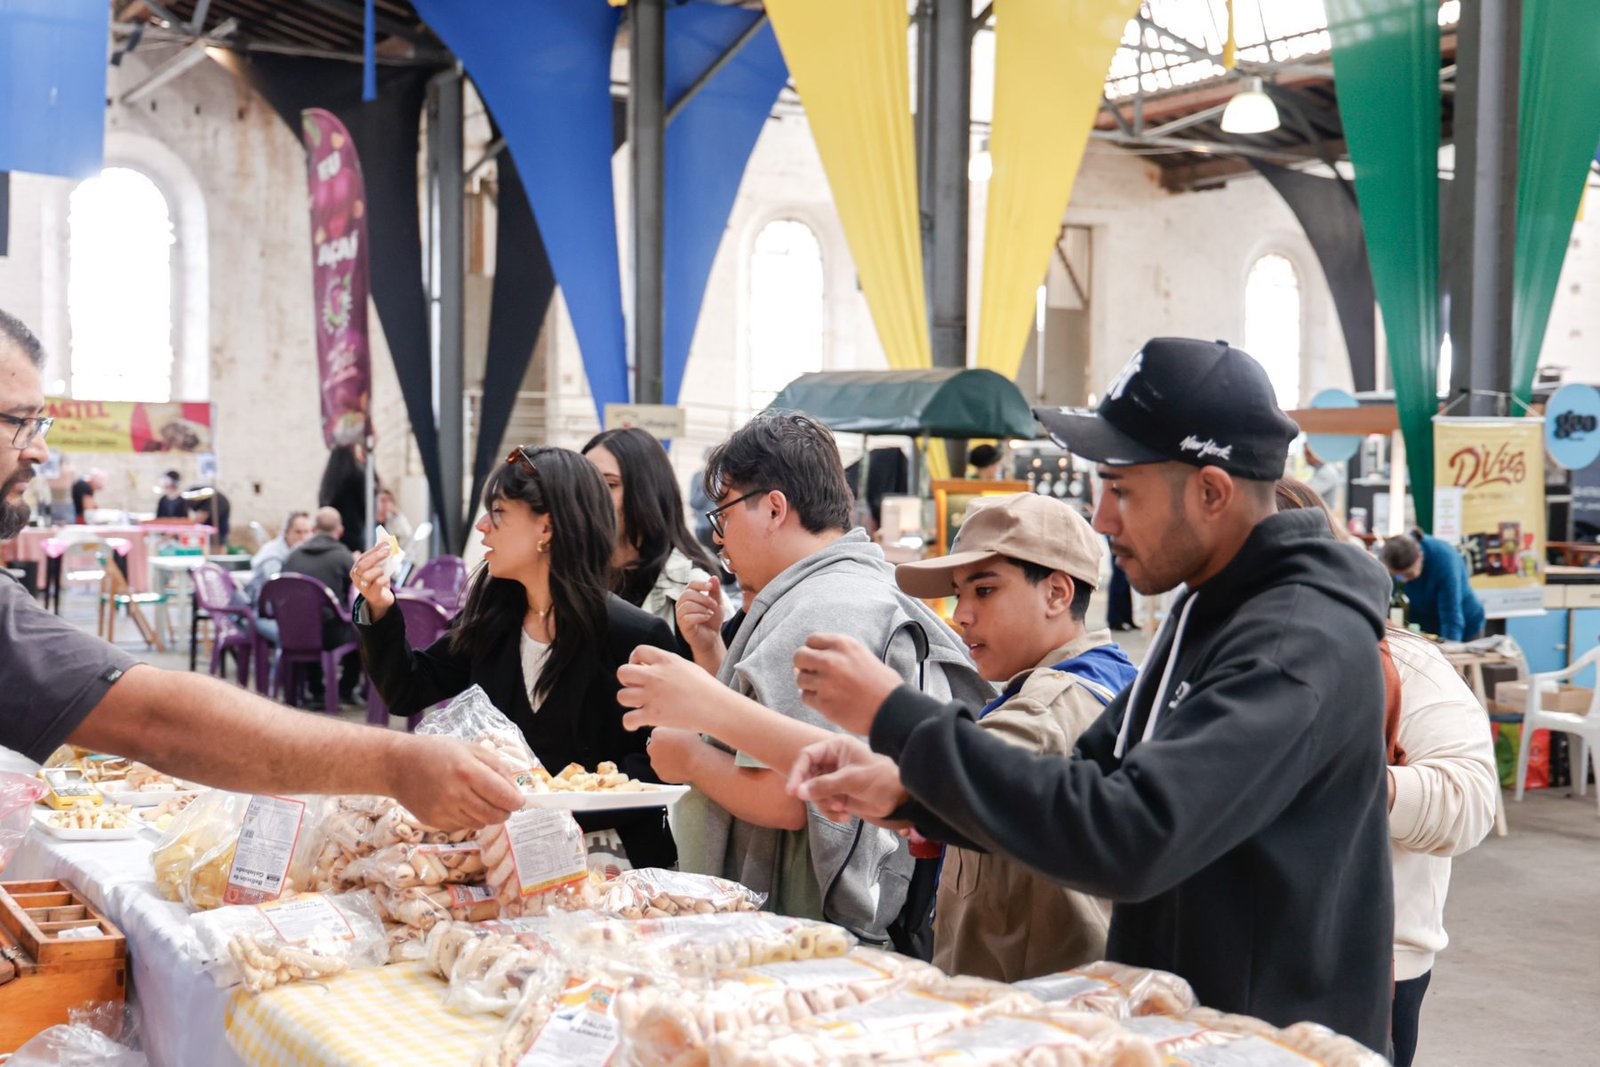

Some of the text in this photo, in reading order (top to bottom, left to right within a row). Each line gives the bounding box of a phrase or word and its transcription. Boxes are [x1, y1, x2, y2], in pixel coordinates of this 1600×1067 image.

[45, 400, 110, 419] ASTEL
[1179, 434, 1233, 460] New York
